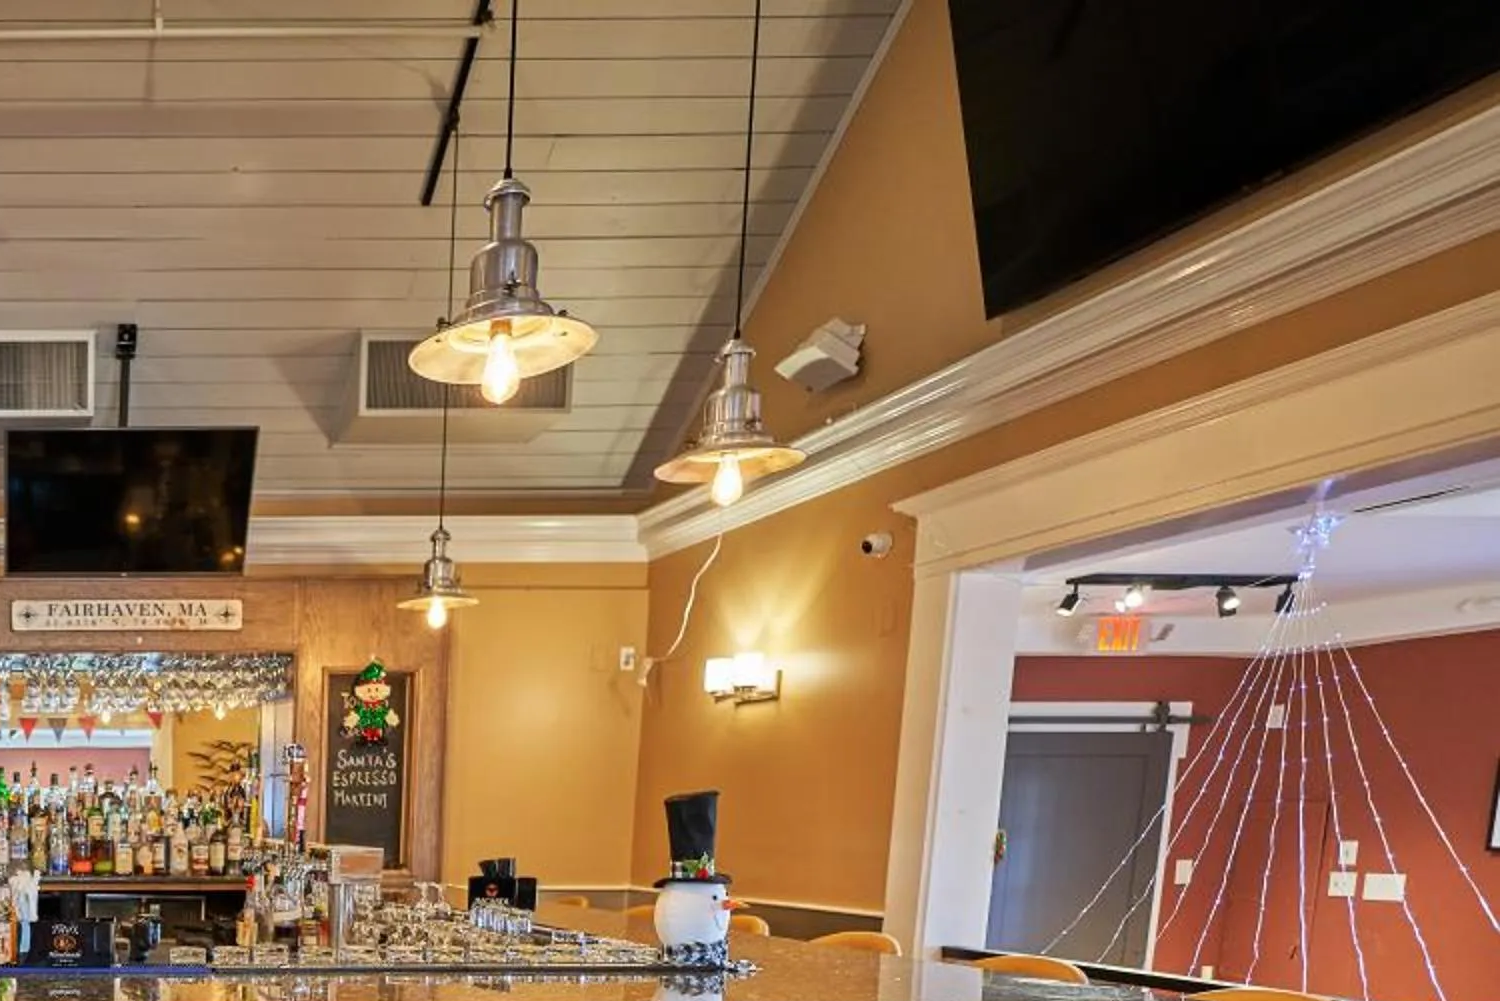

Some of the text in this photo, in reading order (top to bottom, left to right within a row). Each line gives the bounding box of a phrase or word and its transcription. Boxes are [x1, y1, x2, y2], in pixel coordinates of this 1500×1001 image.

[48, 603, 208, 618] FAIRHAVEN, MA
[1098, 617, 1140, 651] EXIT
[332, 770, 397, 787] ESPRESSO
